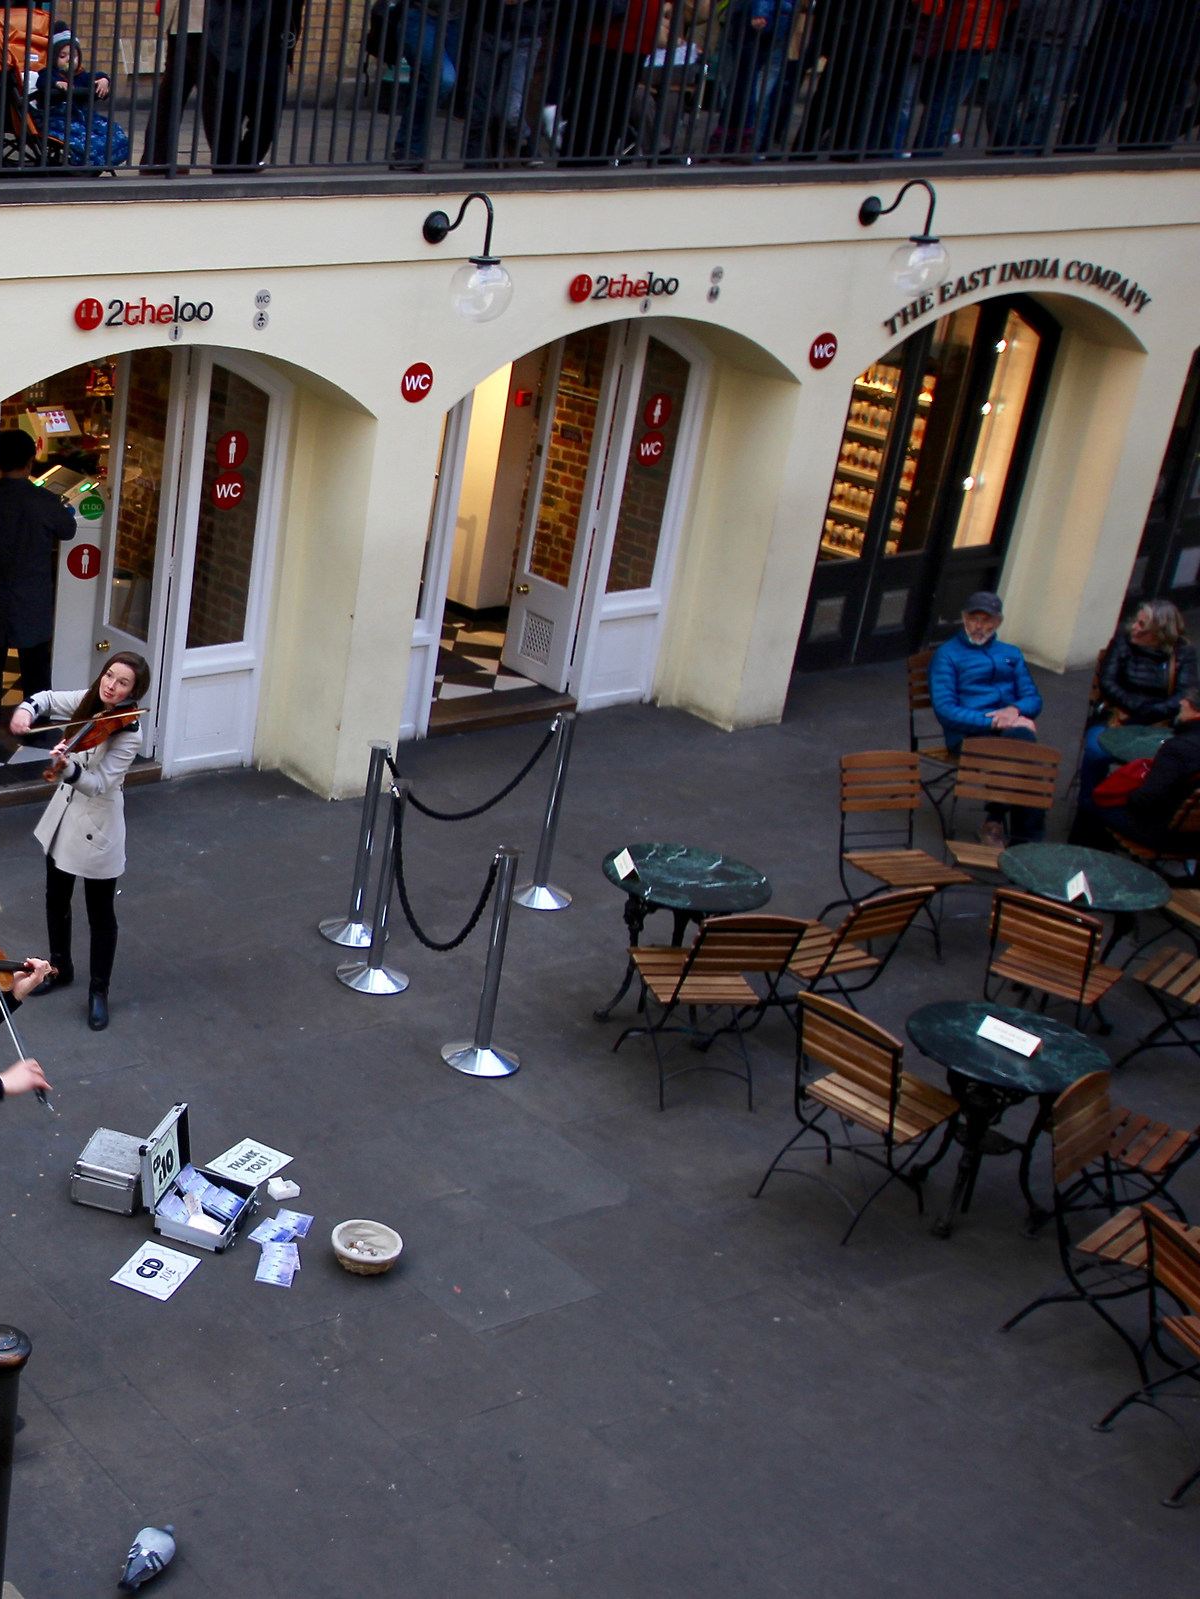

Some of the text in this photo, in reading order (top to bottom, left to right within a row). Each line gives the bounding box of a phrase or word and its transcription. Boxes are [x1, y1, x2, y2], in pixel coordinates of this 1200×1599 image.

[592, 271, 680, 300] 2theloo
[256, 294, 271, 304] WC
[883, 258, 1152, 336] THE EAST INDIA COMPANY
[105, 295, 214, 327] 2theloo
[814, 342, 836, 359] WC
[405, 374, 431, 391] WC
[640, 441, 662, 457] WC
[216, 482, 242, 499] WC
[227, 1149, 260, 1172] THANK
[245, 1155, 273, 1174] YOU!
[136, 1257, 164, 1279] CD
